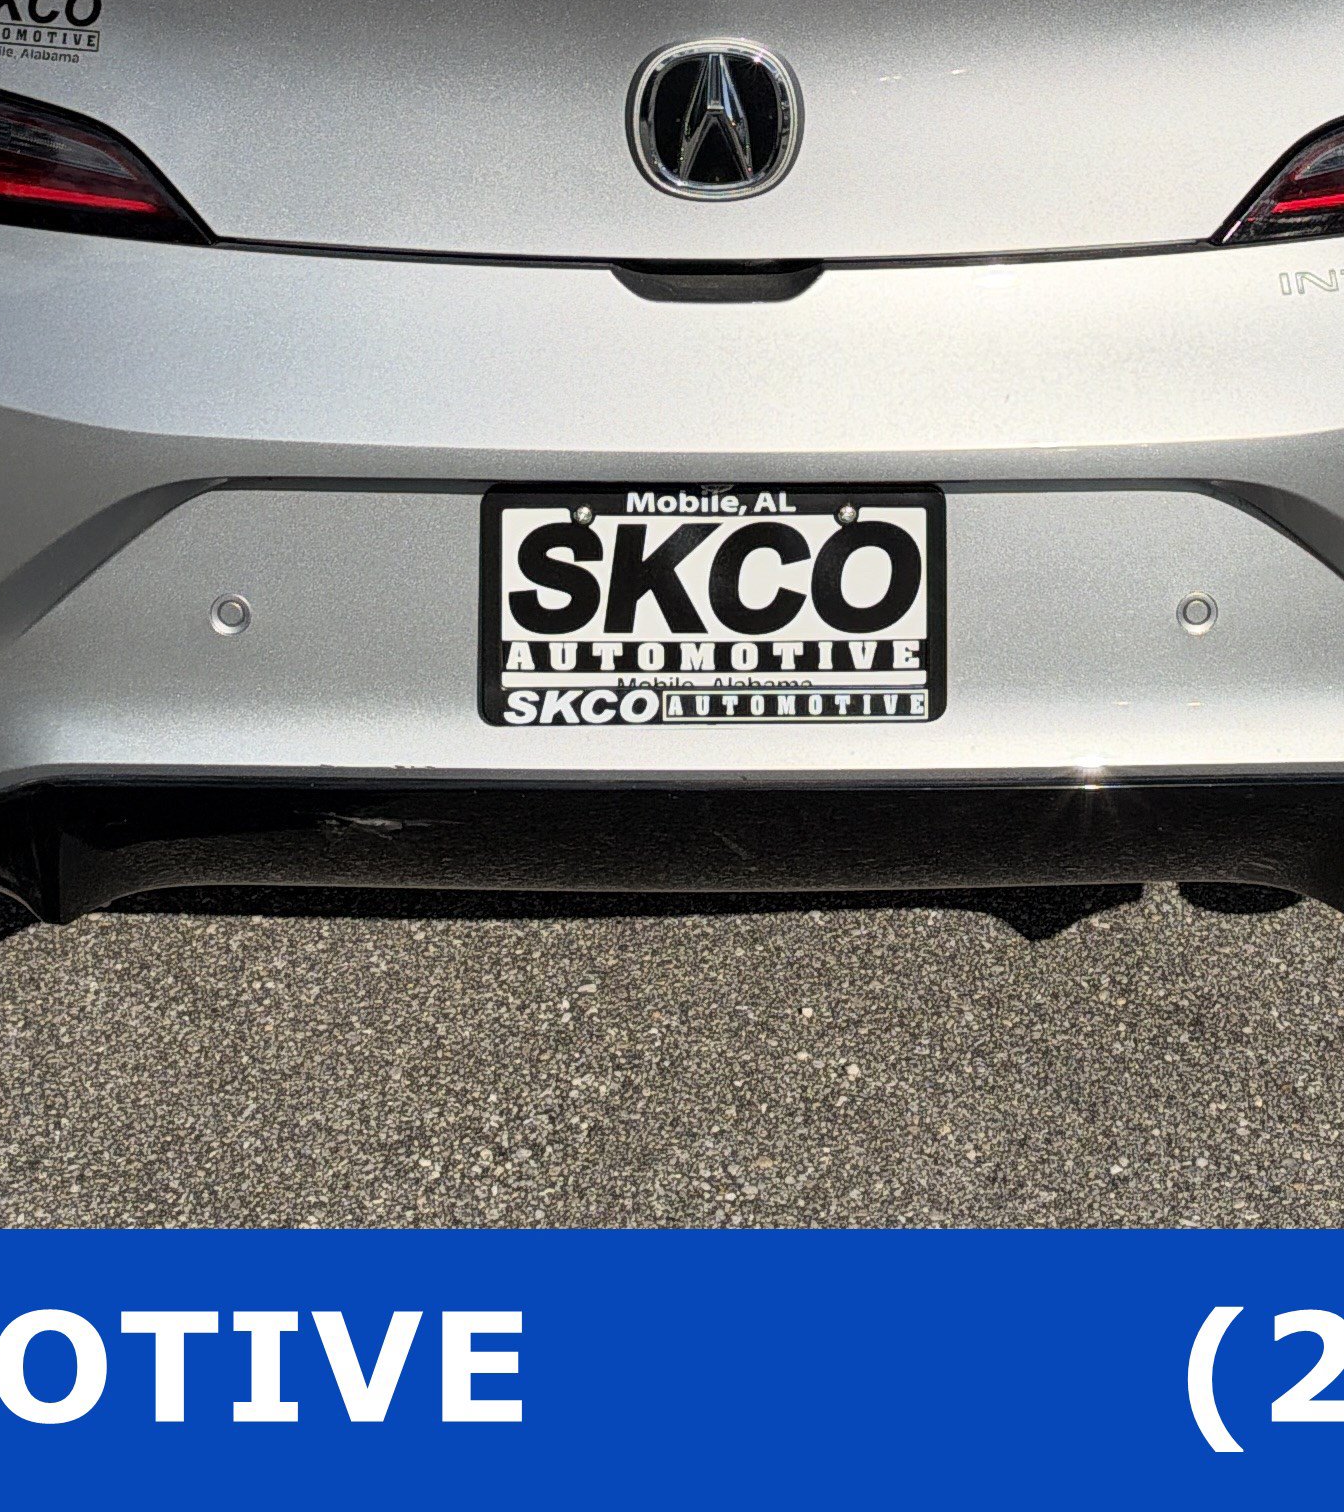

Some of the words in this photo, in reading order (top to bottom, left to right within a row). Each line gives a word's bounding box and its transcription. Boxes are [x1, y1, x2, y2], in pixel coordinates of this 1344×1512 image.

[20, 47, 81, 64] Alabama
[625, 491, 748, 517] Mobile,
[753, 491, 797, 514] AL
[508, 520, 922, 635] SKCO
[505, 640, 921, 672] AUTOMOTIVE
[504, 689, 659, 725] SKCO
[667, 693, 925, 717] AUTOMOTIVE
